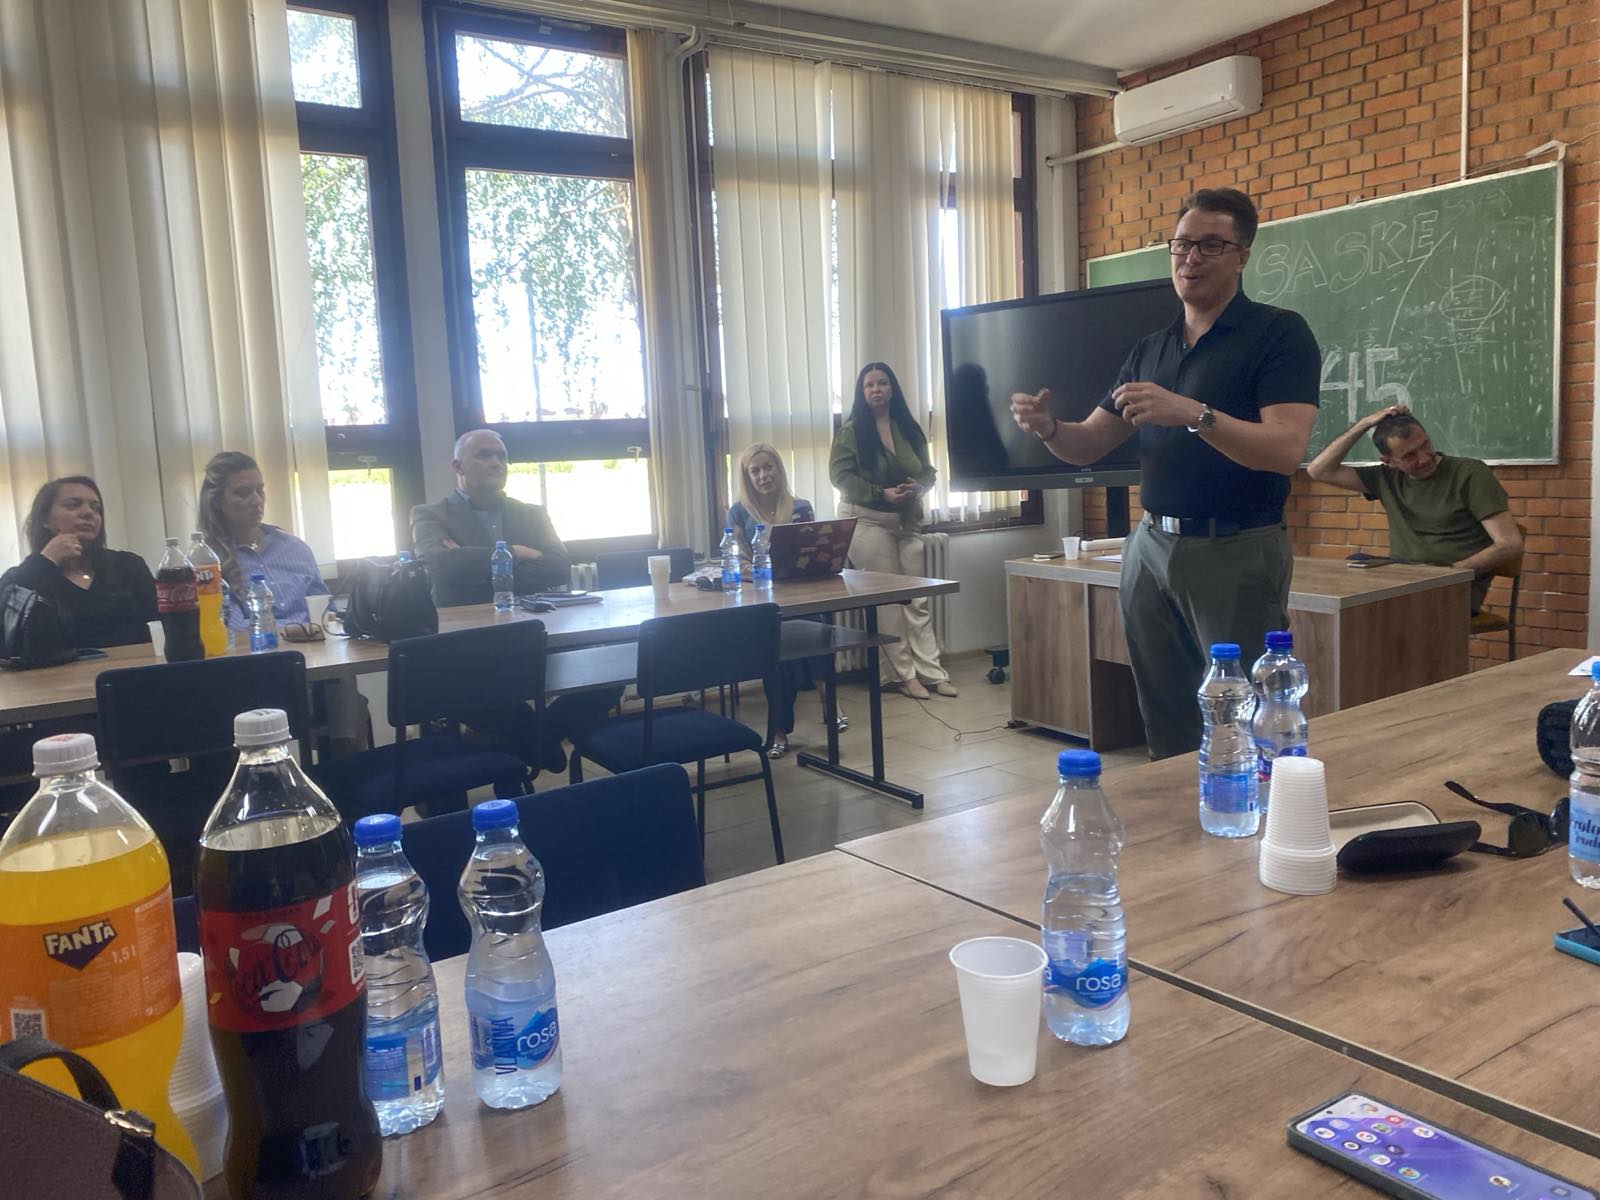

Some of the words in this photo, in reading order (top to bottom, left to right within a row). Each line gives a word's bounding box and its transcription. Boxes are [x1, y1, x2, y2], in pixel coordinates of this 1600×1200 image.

[1256, 210, 1439, 304] SASKE
[45, 922, 115, 955] FANTA
[1076, 973, 1121, 991] rosa
[517, 1021, 557, 1052] rosa
